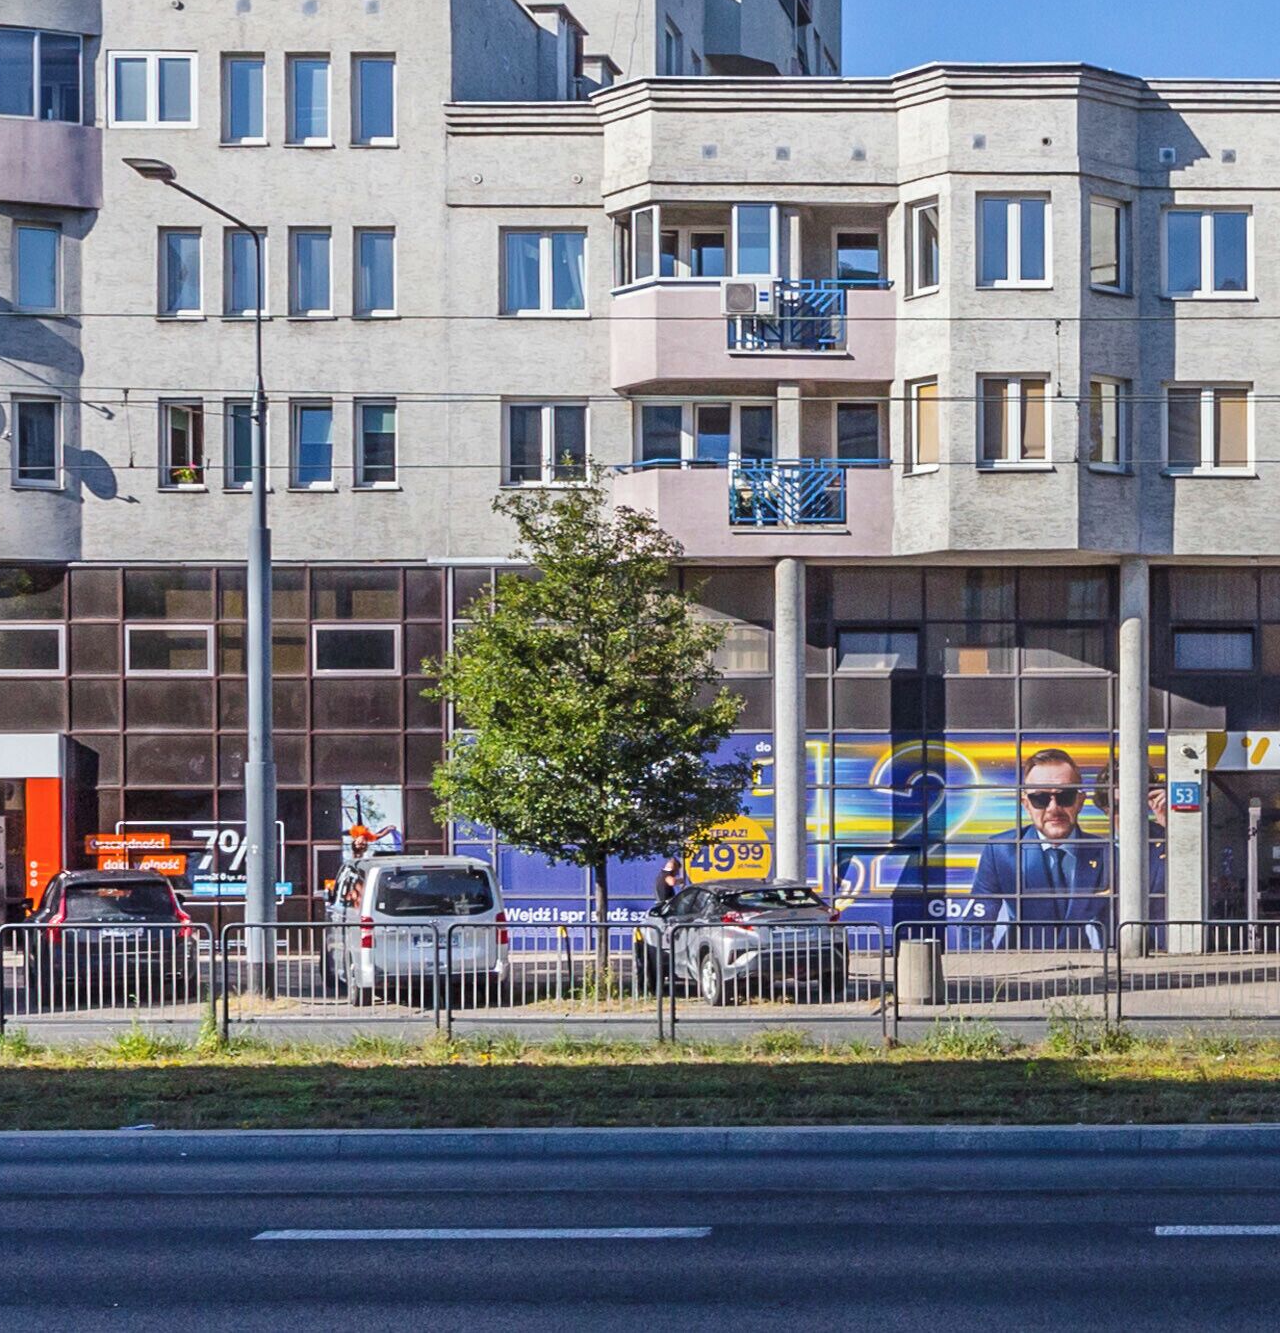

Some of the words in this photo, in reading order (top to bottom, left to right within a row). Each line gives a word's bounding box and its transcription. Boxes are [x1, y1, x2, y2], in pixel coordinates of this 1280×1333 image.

[755, 741, 772, 753] do
[1175, 788, 1195, 804] 53
[710, 828, 748, 839] TERAZ!
[689, 843, 736, 873] 49
[737, 843, 764, 861] 99
[505, 907, 552, 923] Wejdź
[552, 908, 559, 922] i
[927, 898, 986, 917] Gb/s
